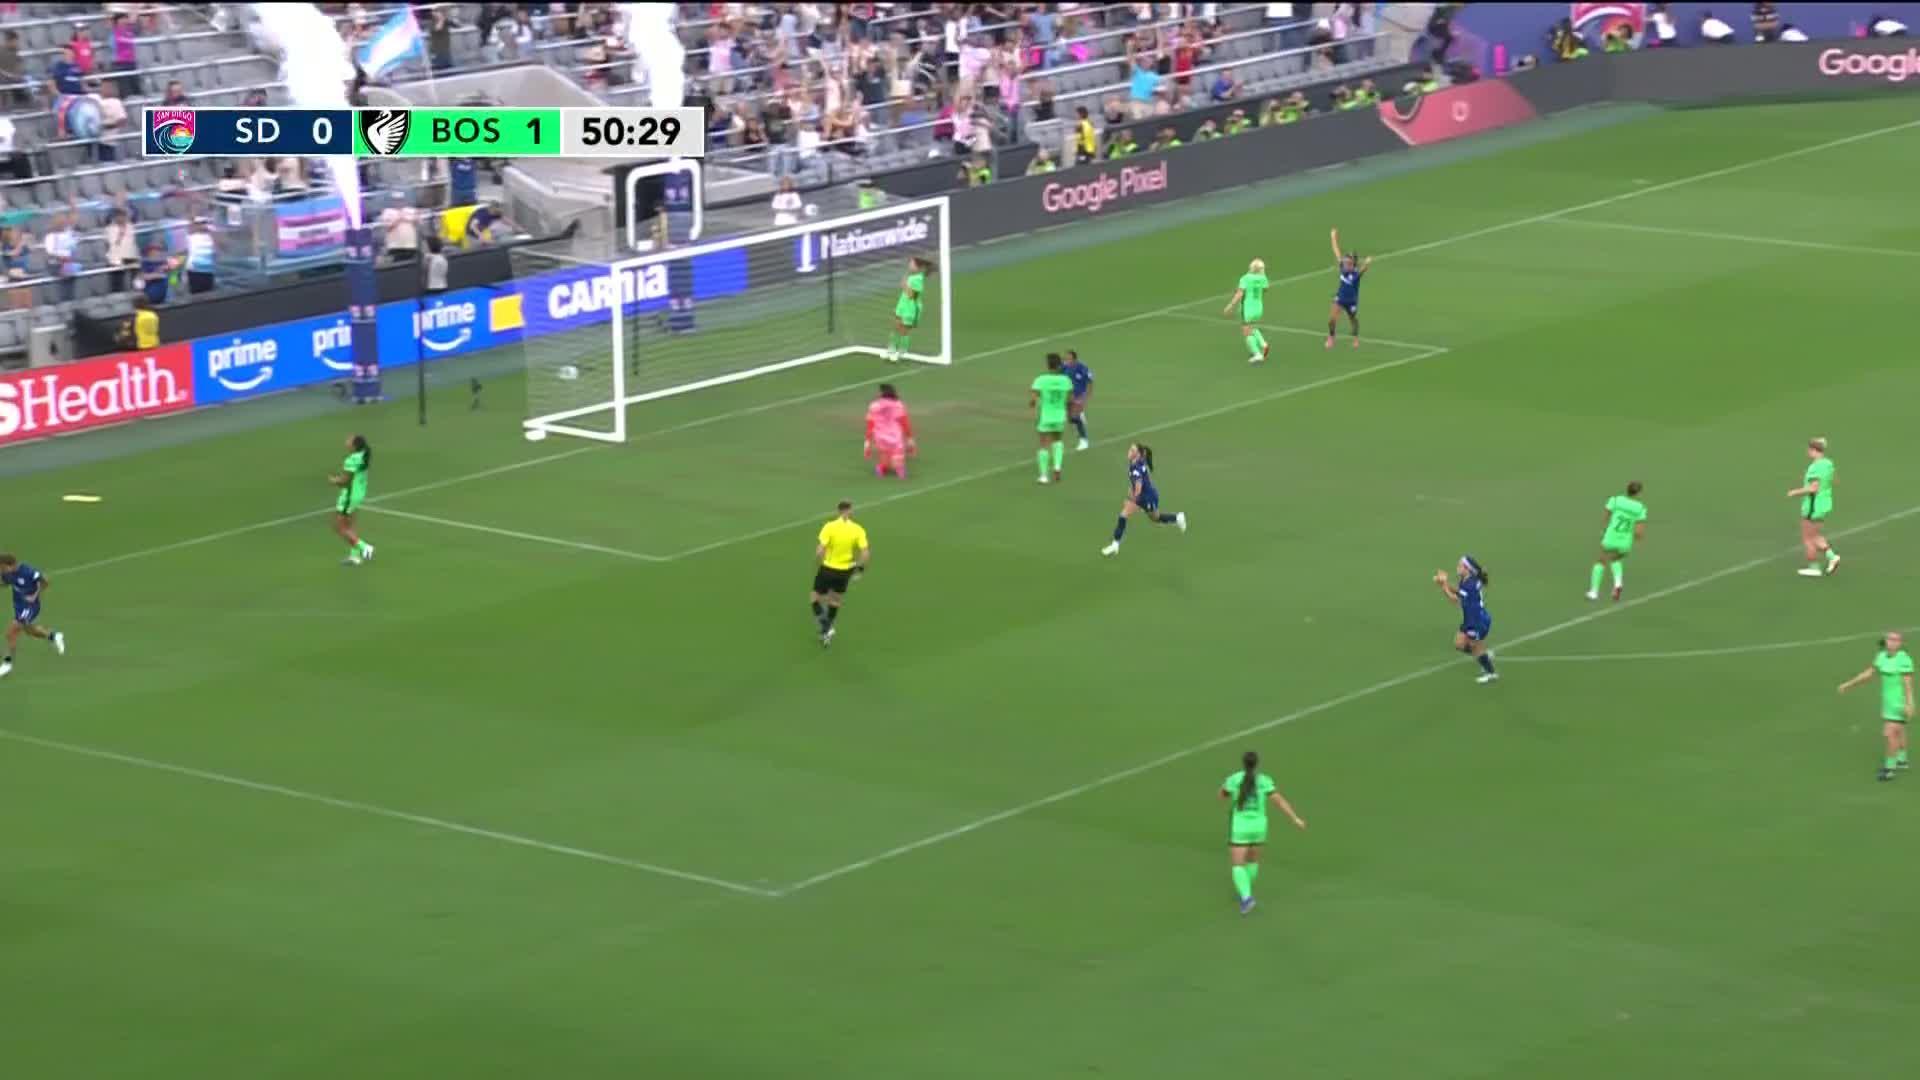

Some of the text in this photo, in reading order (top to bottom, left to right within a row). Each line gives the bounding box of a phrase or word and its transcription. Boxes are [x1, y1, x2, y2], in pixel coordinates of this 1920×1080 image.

[1043, 160, 1168, 212] Google Pixel
[820, 215, 929, 260] Nationwide
[312, 319, 352, 358] pri
[412, 301, 476, 339] prime
[208, 338, 278, 378] prime
